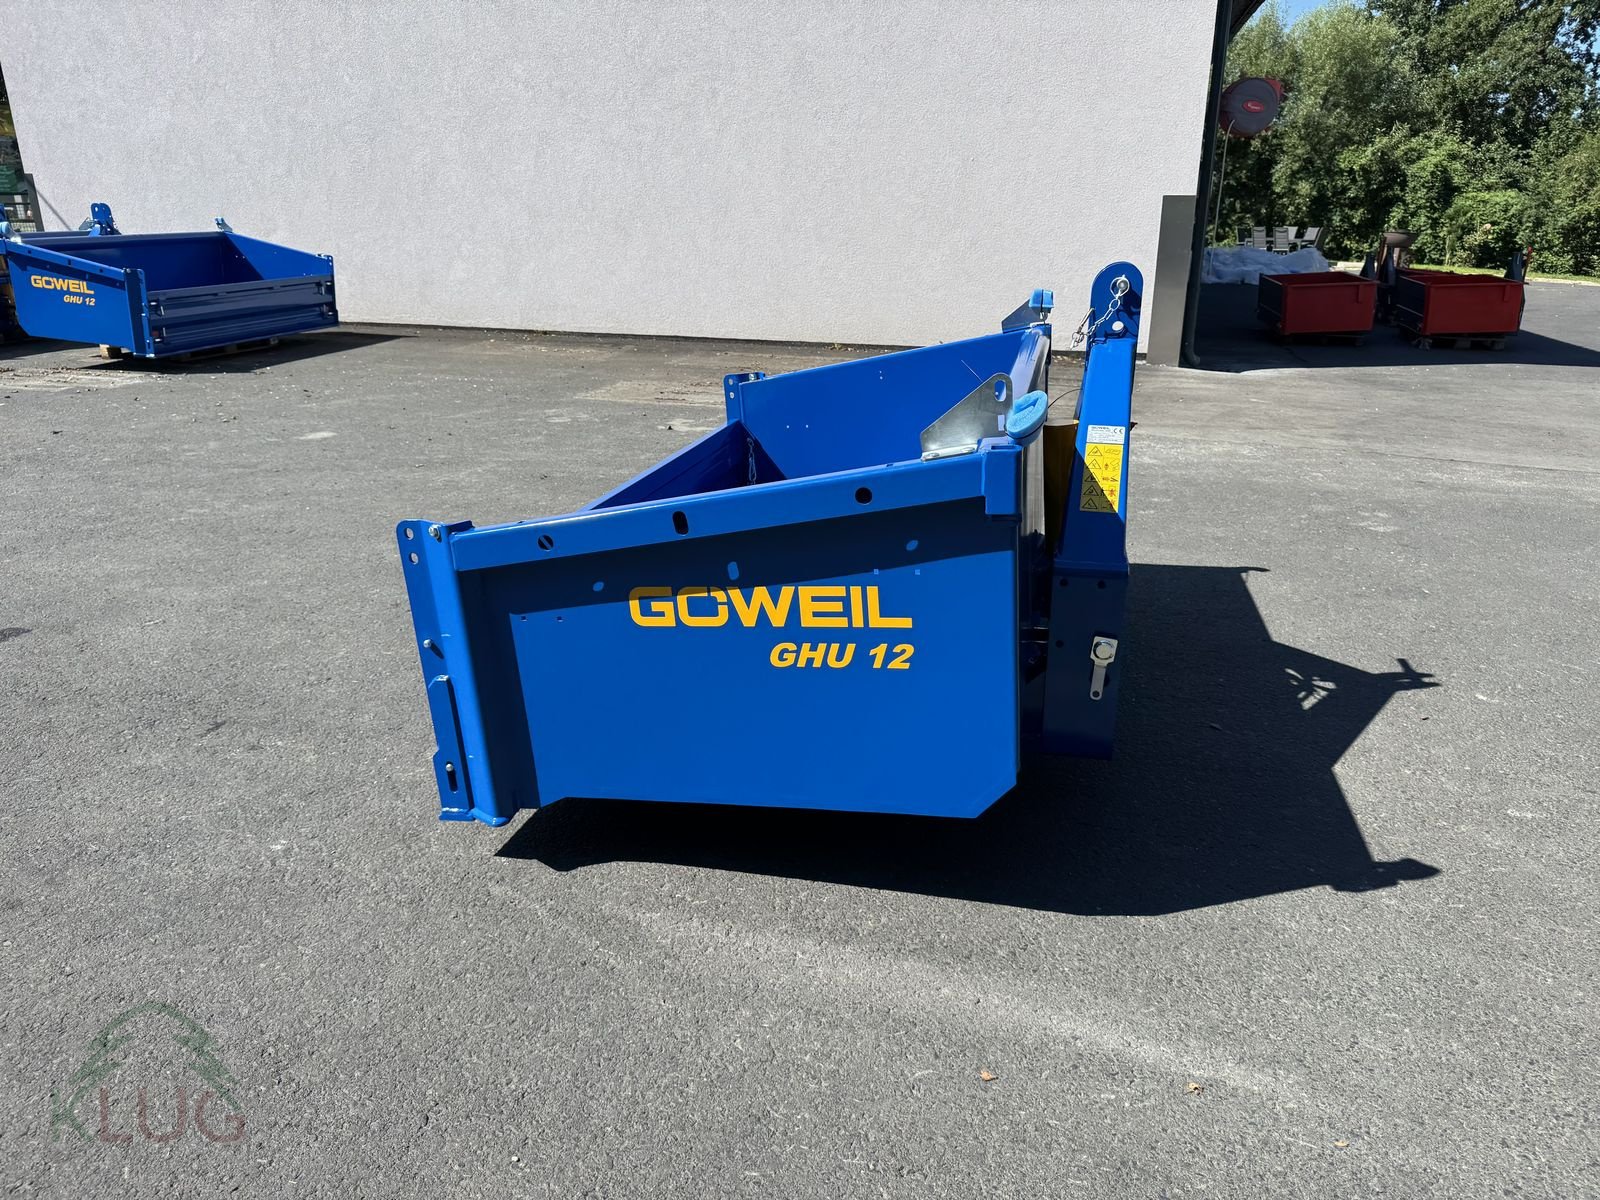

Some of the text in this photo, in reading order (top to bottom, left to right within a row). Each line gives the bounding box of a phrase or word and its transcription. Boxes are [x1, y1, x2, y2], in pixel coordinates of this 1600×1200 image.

[63, 294, 96, 306] GHU 12
[769, 642, 915, 670] GHU 12
